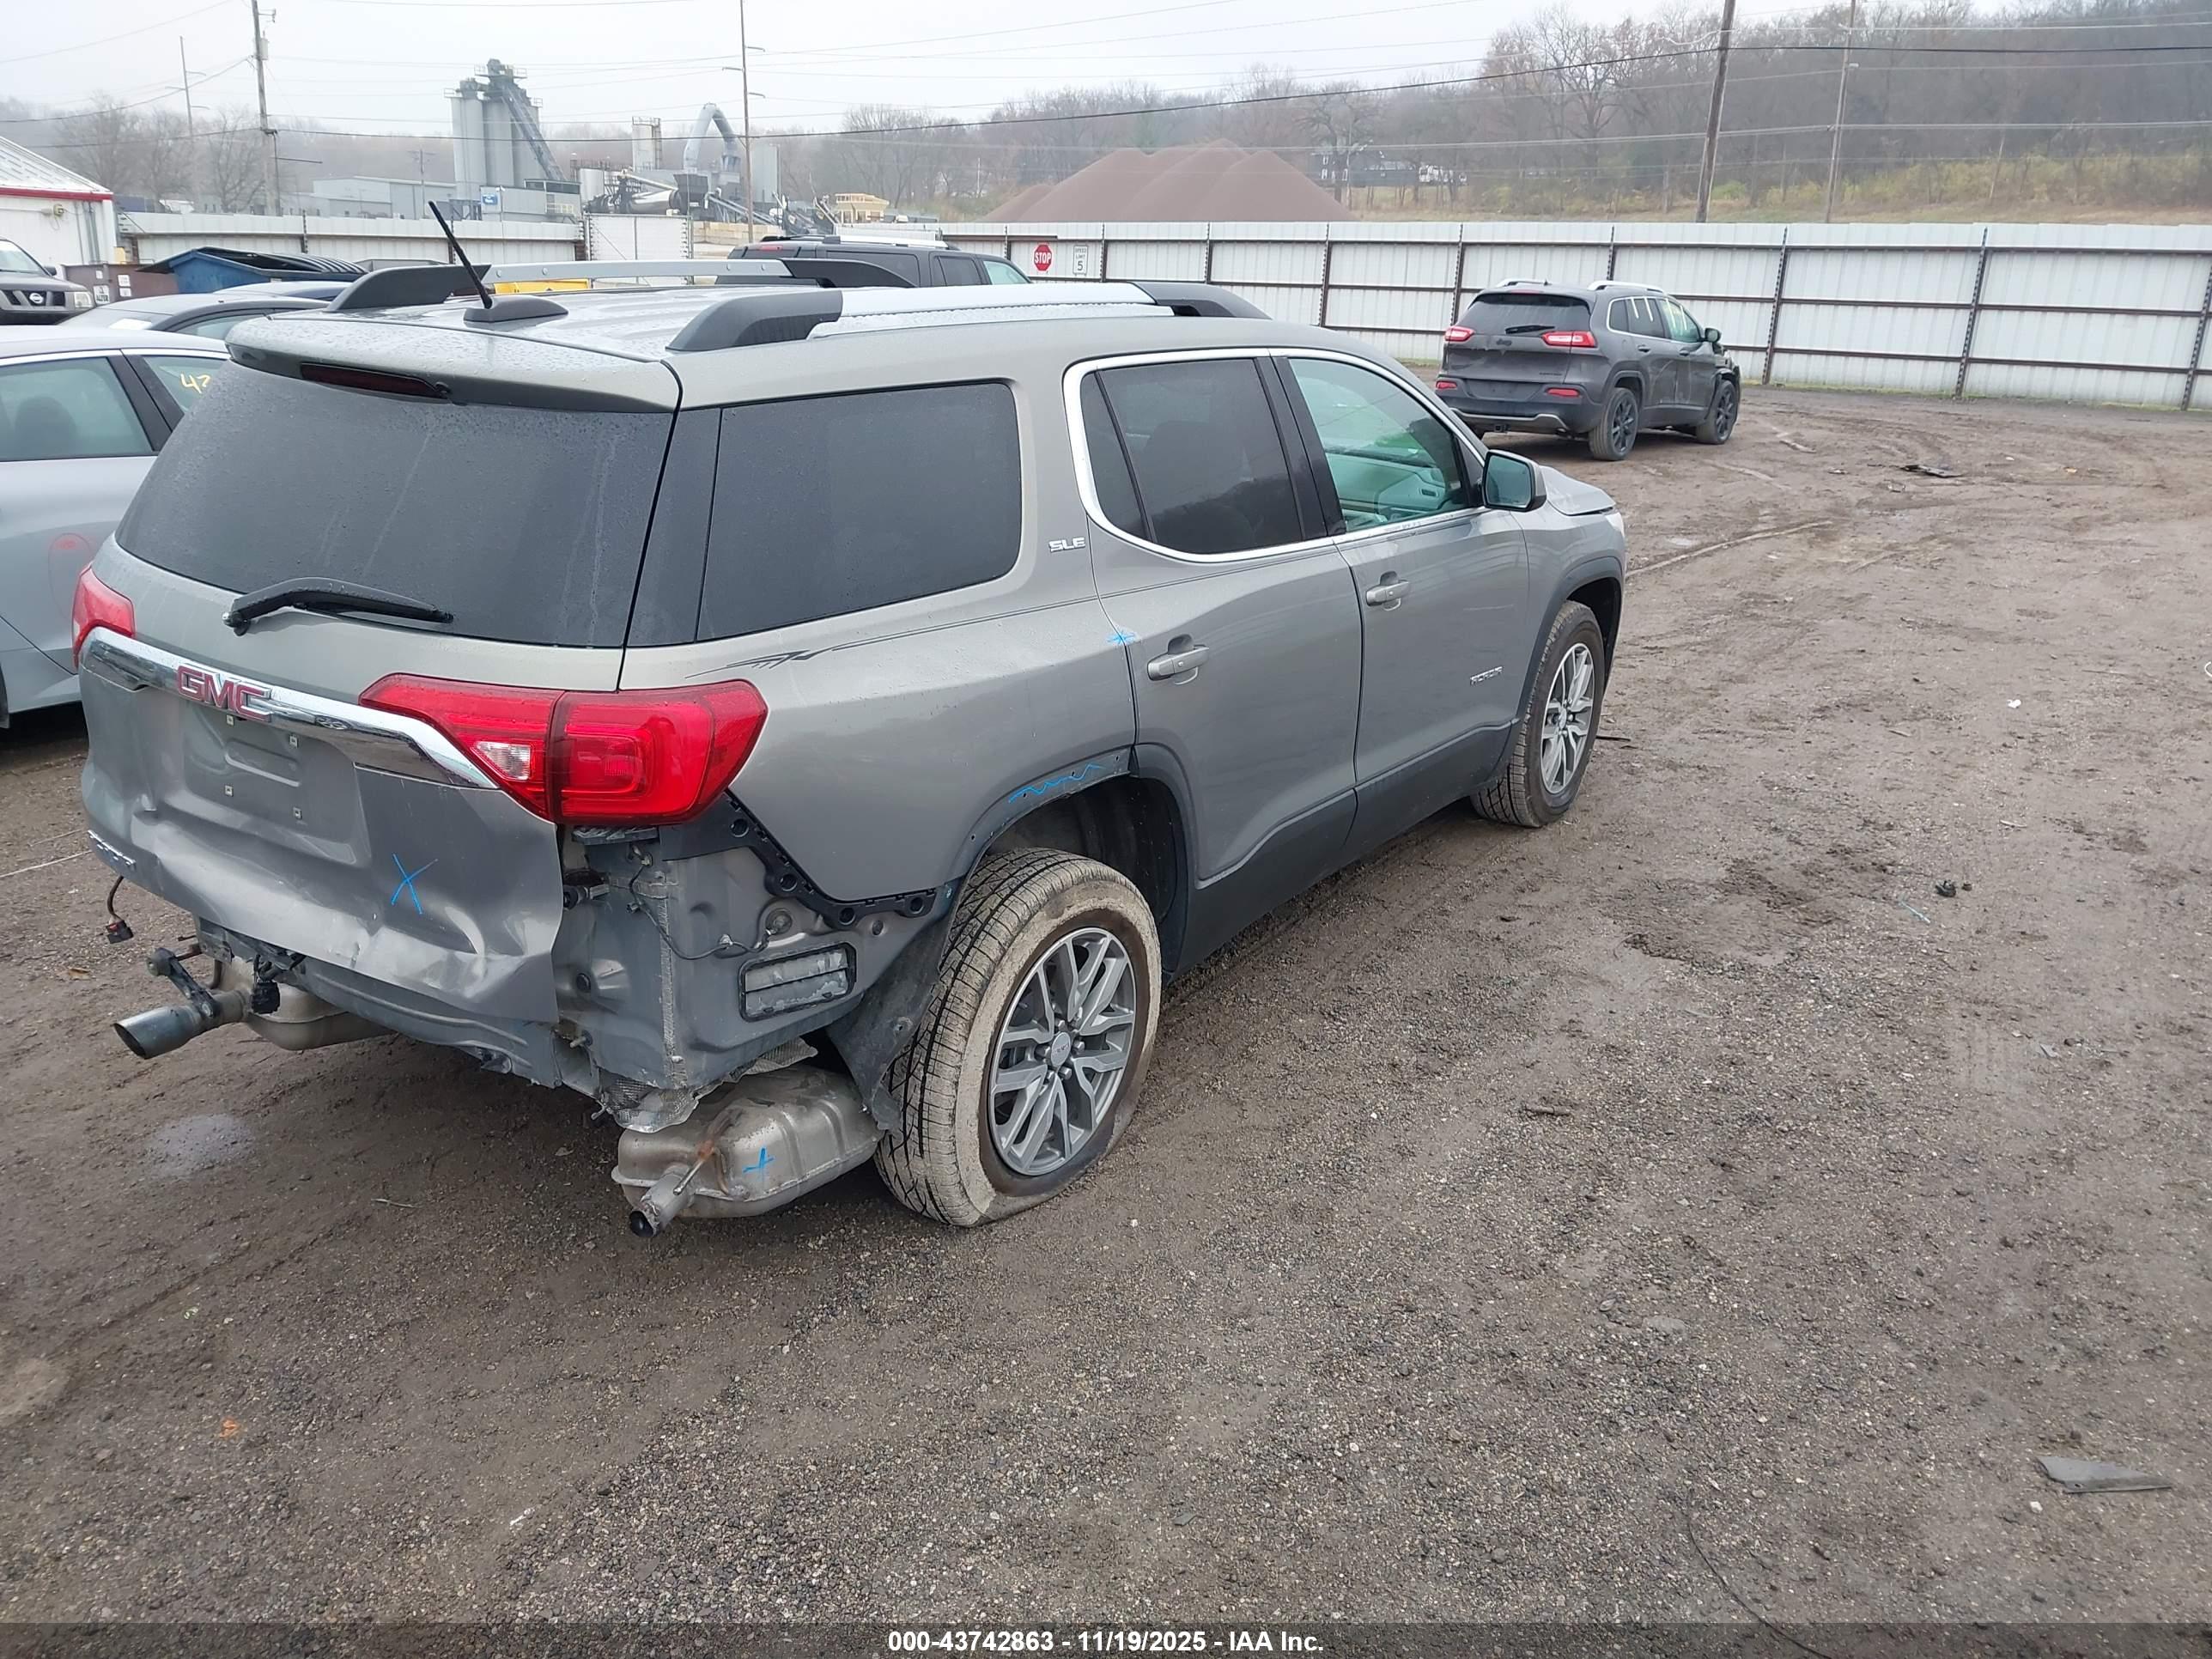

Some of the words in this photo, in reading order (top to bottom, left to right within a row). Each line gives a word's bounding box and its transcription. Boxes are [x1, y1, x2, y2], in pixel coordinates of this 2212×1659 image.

[1035, 252, 1052, 264] STOP
[1077, 260, 1084, 271] 5
[1048, 537, 1086, 553] SLE
[176, 665, 272, 722] GMC
